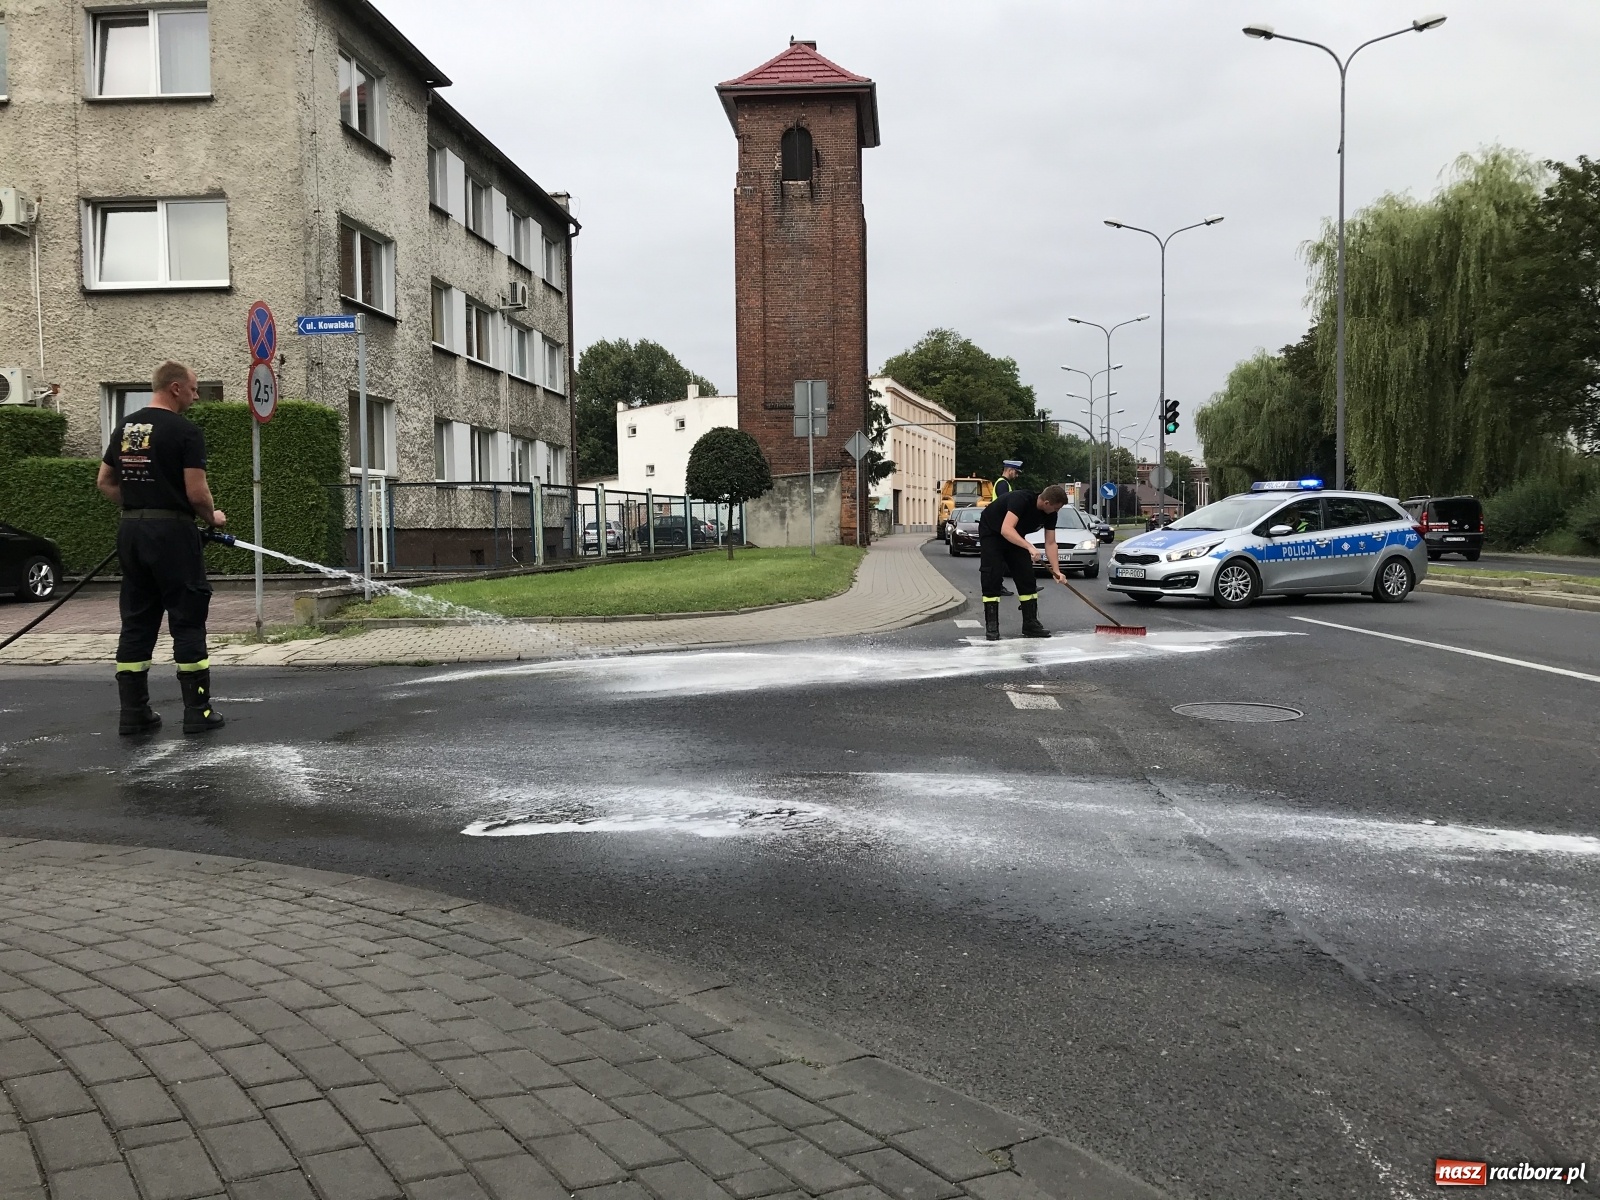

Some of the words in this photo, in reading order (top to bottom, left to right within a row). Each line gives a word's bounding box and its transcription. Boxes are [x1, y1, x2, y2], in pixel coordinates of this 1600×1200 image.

[306, 321, 316, 330] ul.
[318, 320, 354, 330] Kowalska
[1282, 544, 1317, 557] POLICJA
